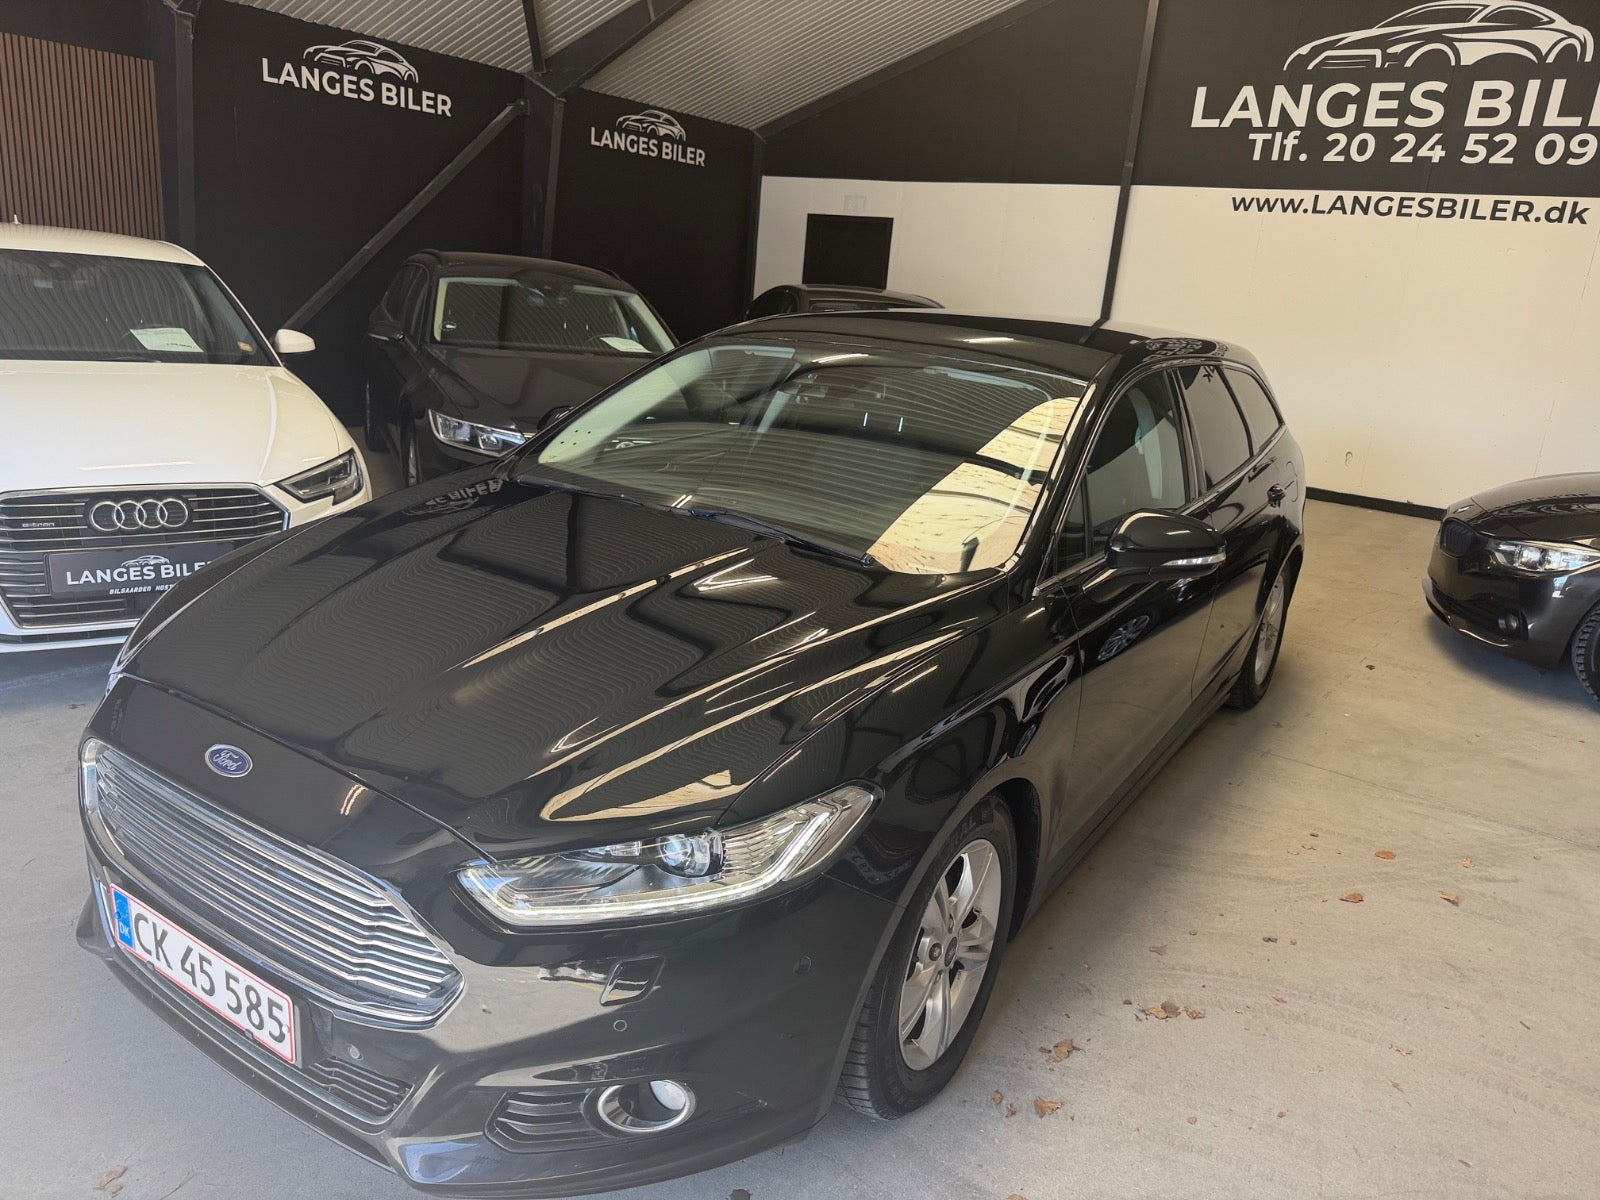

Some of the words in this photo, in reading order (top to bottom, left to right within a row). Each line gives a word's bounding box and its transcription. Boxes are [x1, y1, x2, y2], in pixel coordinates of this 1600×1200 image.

[262, 57, 375, 102] LANGES
[381, 82, 452, 117] BILER
[1190, 80, 1449, 128] LANGES
[590, 126, 658, 157] LANGES
[661, 141, 706, 167] BILER
[1248, 130, 1309, 162] Tlf.
[1322, 132, 1376, 163] 20
[1389, 132, 1447, 163] 24
[1460, 132, 1518, 164] 52
[1534, 132, 1598, 166] 09
[1231, 194, 1592, 226] www.LANGESBILER.dk
[66, 565, 156, 585] LANGES
[160, 561, 213, 579] BILE
[109, 585, 152, 595] BILGAARDEN
[213, 750, 243, 771] Ford
[119, 921, 131, 939] DK
[133, 912, 173, 970] CK
[180, 945, 215, 997] 45
[225, 969, 286, 1044] 585
